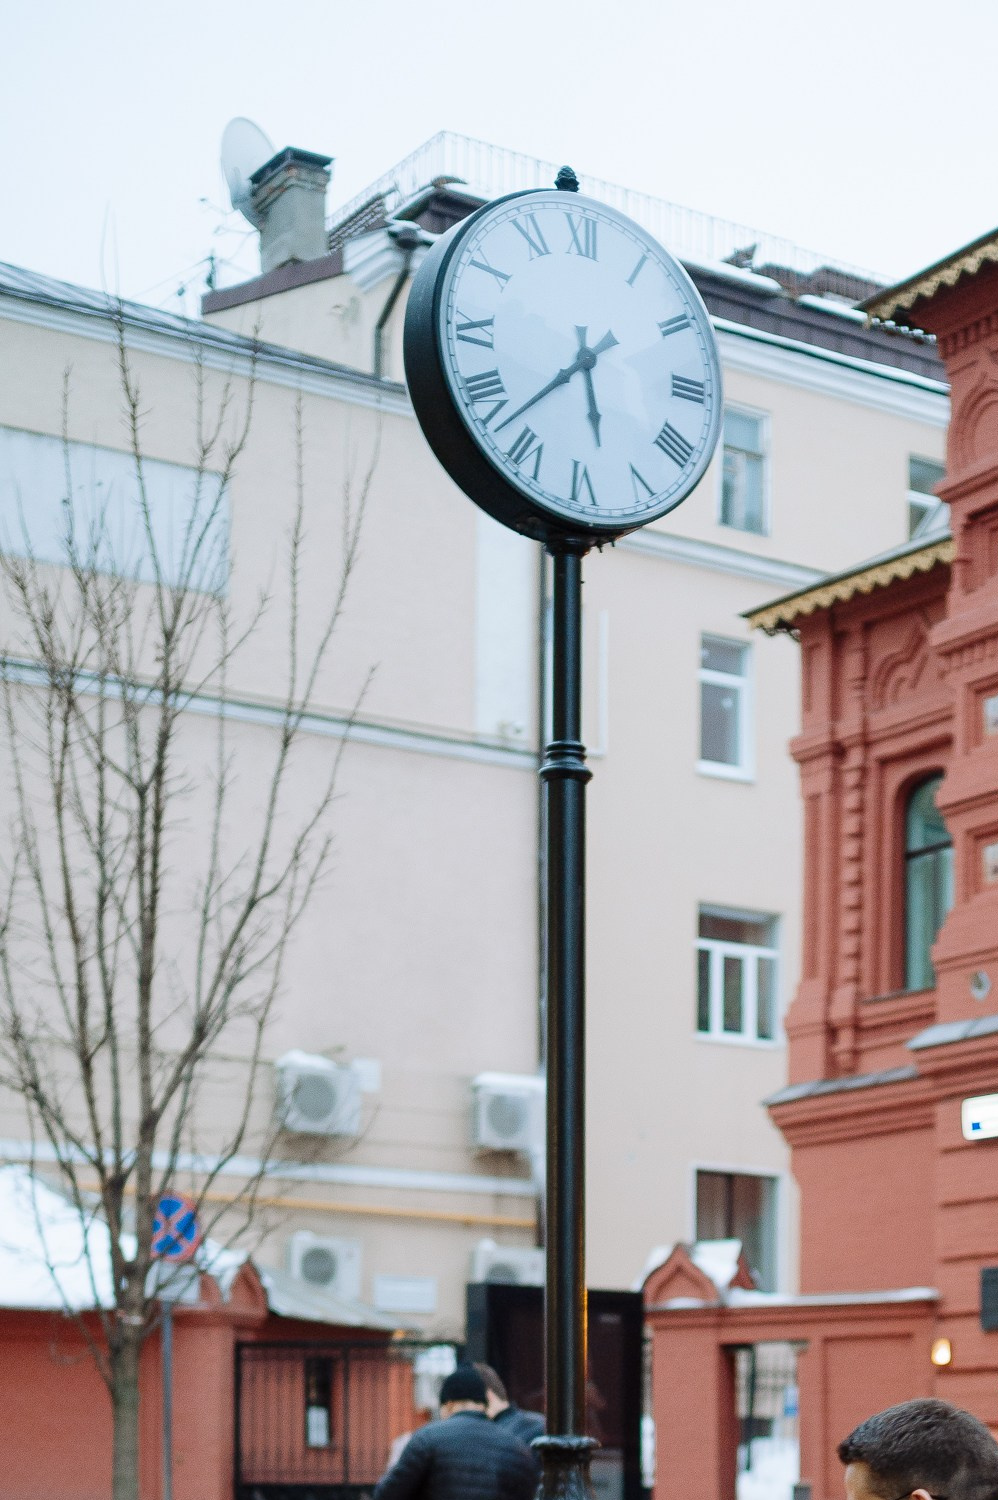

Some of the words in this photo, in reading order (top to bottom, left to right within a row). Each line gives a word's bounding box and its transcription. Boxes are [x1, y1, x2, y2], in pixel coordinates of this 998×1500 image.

[509, 212, 552, 262] XI
[565, 212, 599, 262] XII
[468, 246, 511, 293] X
[625, 252, 651, 288] I
[455, 306, 495, 351] IX
[657, 313, 694, 336] II
[464, 367, 509, 426] VIII
[671, 371, 705, 404] III
[505, 424, 544, 483] VII
[570, 458, 600, 506] VI
[629, 461, 658, 503] V
